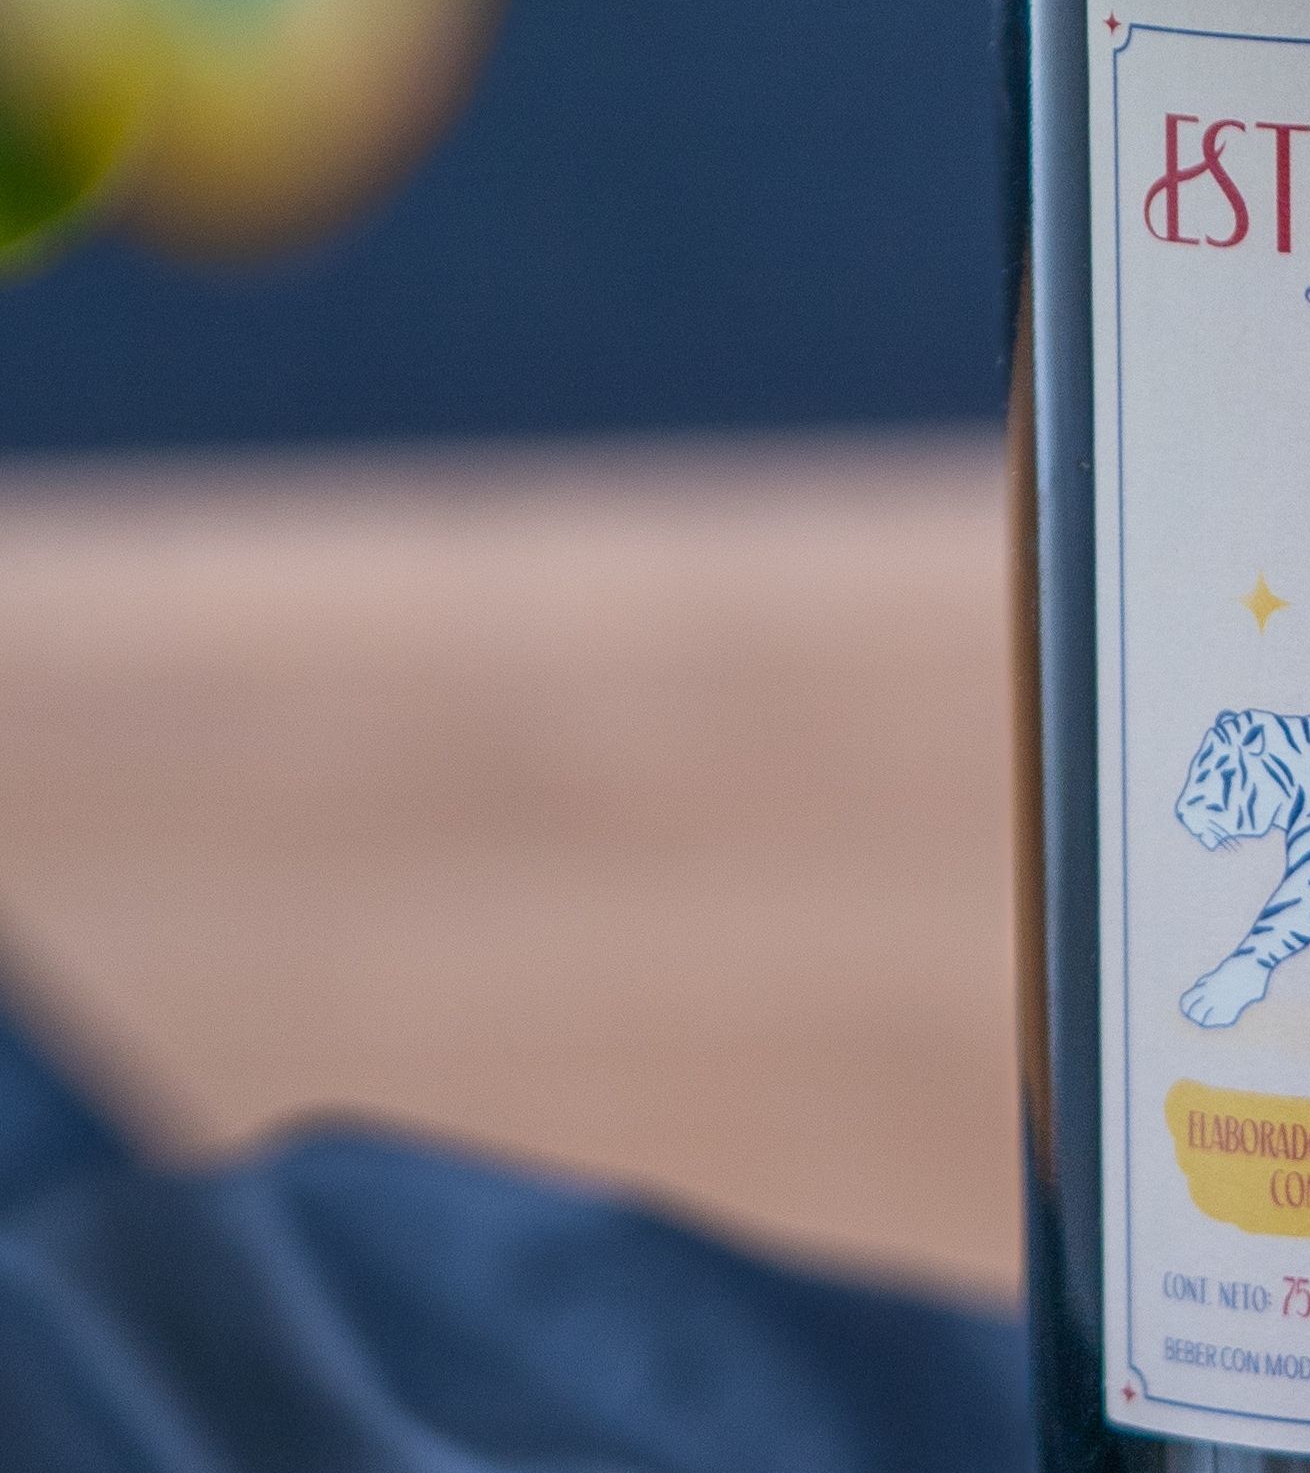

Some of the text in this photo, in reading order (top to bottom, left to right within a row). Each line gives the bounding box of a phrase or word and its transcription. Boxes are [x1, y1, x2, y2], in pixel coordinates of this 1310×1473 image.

[1219, 1280, 1273, 1313] NETO:
[1164, 1336, 1217, 1367] BEBER
[1220, 1346, 1259, 1374] CON
